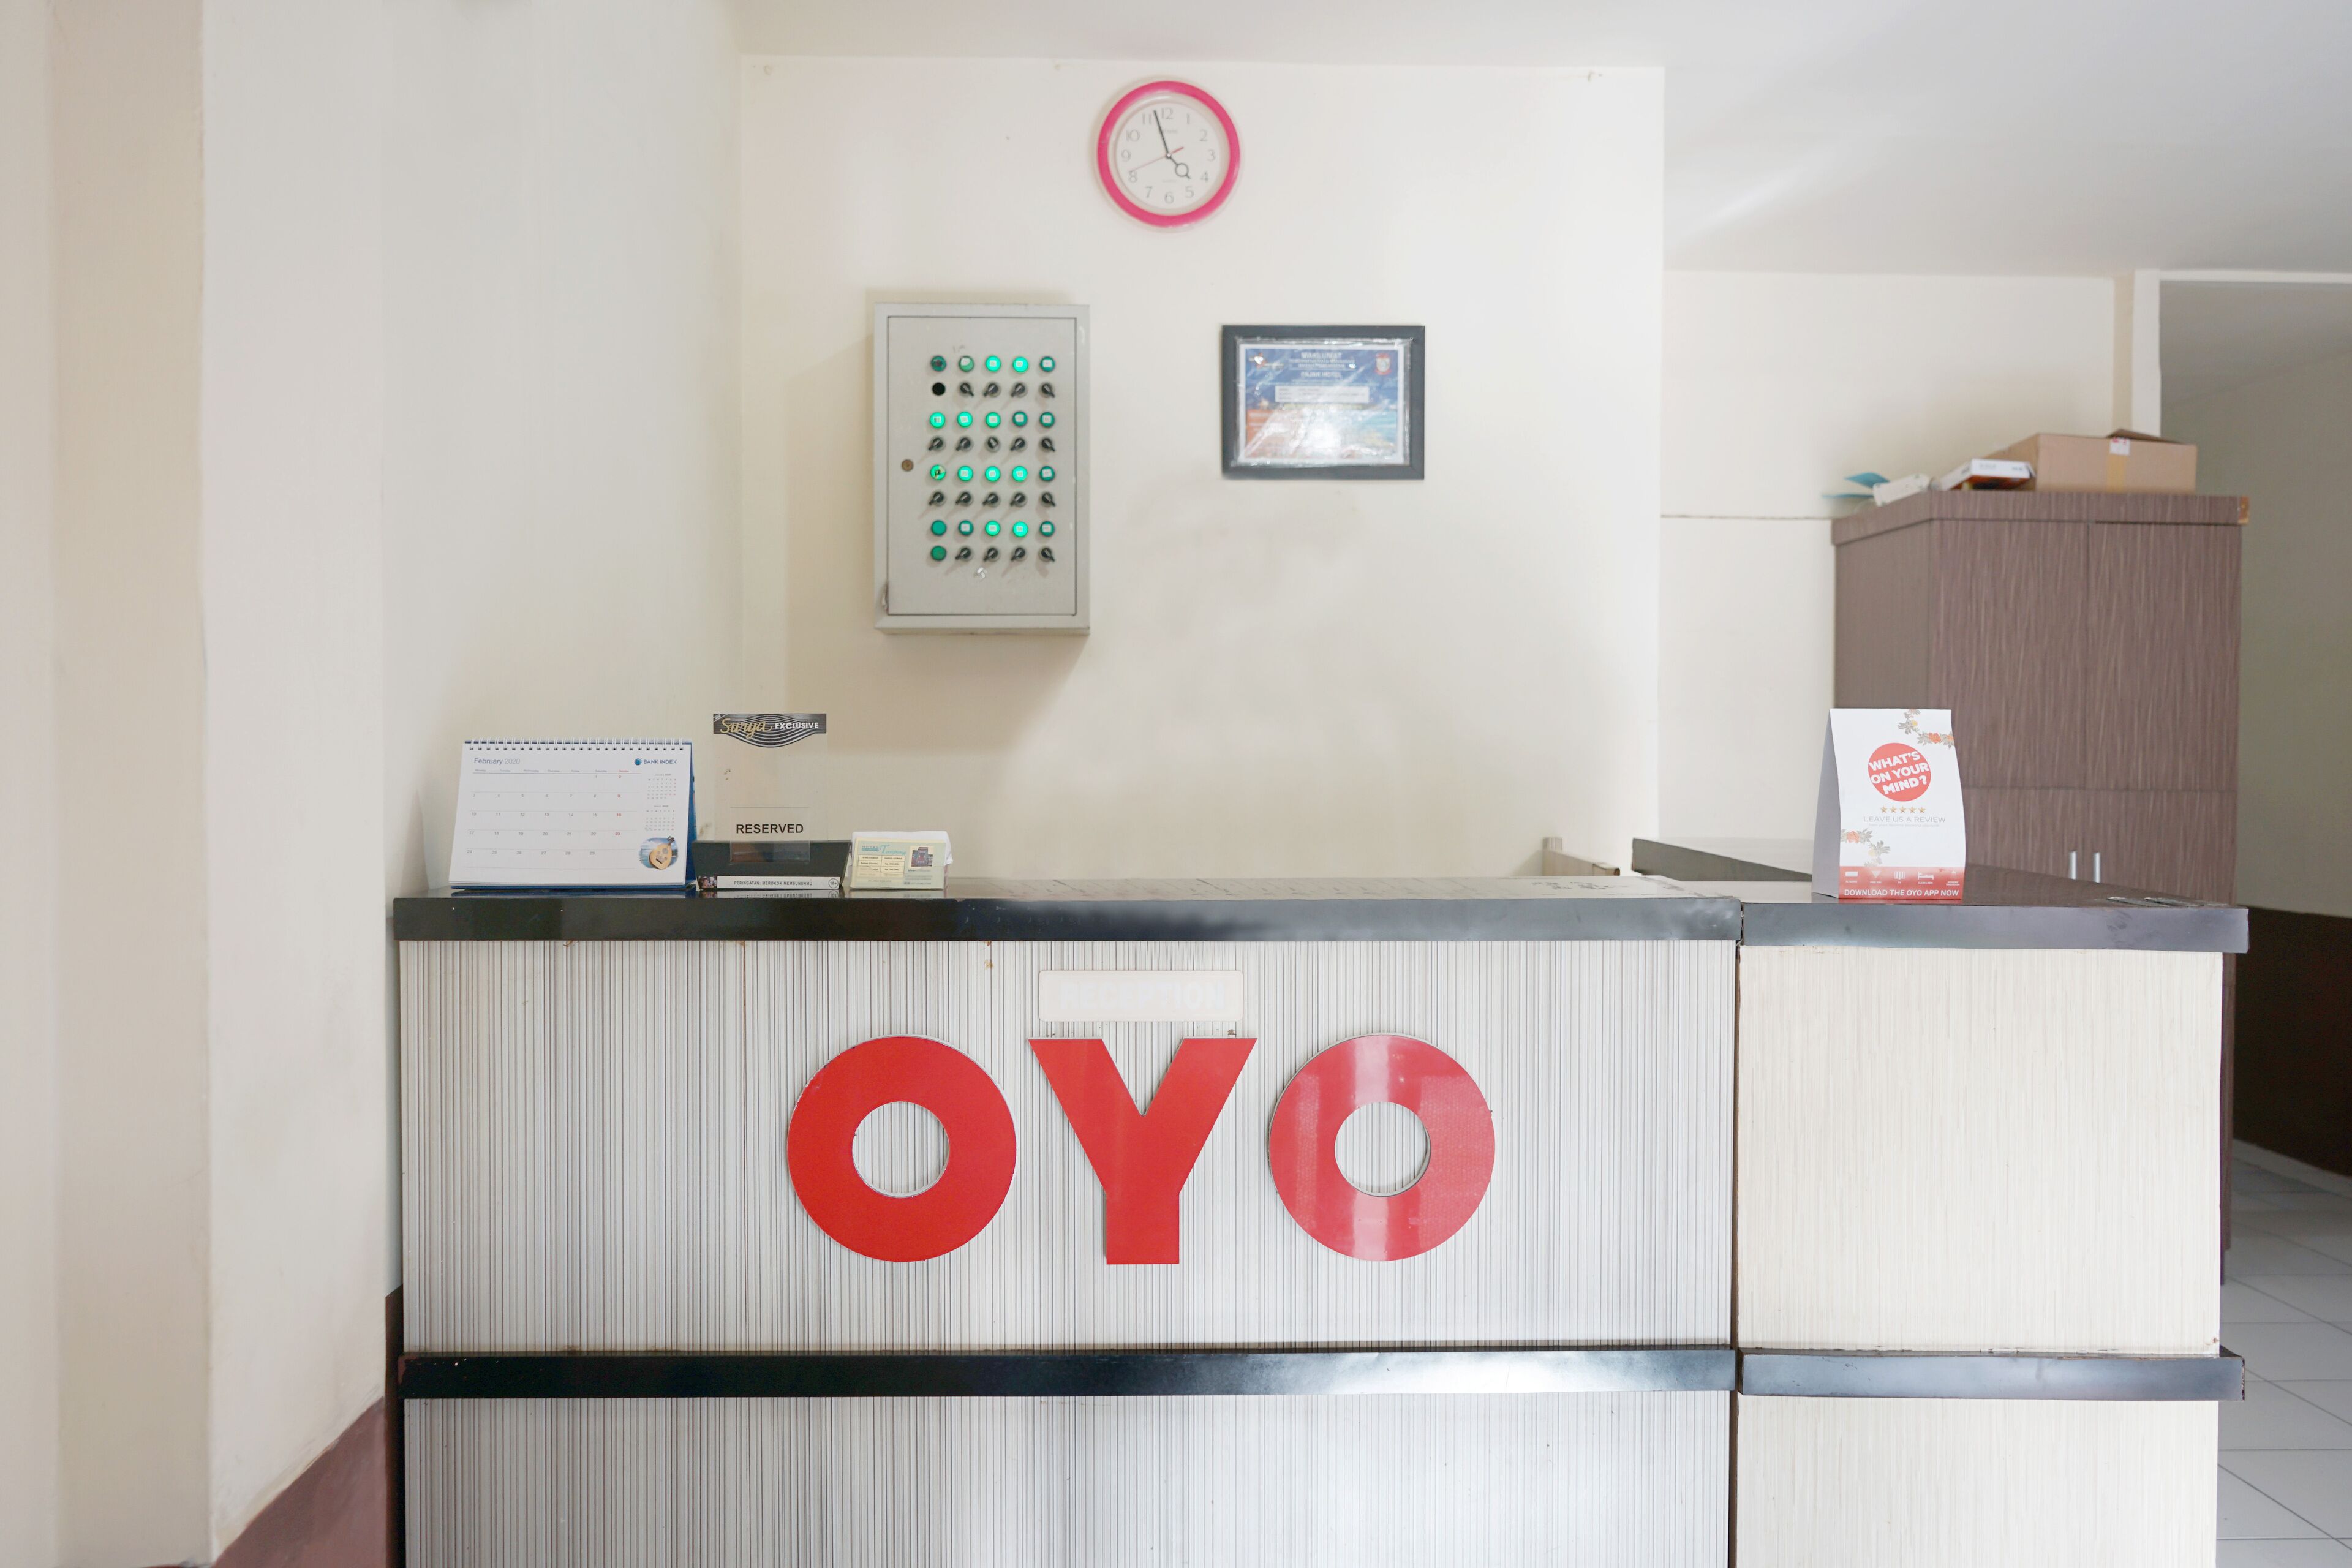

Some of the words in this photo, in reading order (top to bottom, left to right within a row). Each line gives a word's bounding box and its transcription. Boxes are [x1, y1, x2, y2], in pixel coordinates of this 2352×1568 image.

[1142, 113, 1153, 125] 11
[1161, 107, 1174, 120] 12
[1186, 113, 1190, 125] 1
[1126, 130, 1140, 142] 10
[1199, 130, 1208, 141] 2
[1121, 149, 1131, 162] 9
[1207, 149, 1216, 162] 3
[1128, 171, 1138, 183] 8
[1200, 172, 1209, 182] 4
[1145, 186, 1153, 198] 7
[1164, 192, 1175, 204] 6
[1185, 186, 1194, 198] 5
[720, 718, 772, 739] Surya
[775, 722, 819, 730] EXCLUSIVE
[1869, 750, 1920, 771] WHAT'S
[1871, 771, 1891, 784] ON
[1892, 762, 1929, 778] YOUR
[736, 823, 804, 834] RESERVED
[1058, 980, 1226, 1010] RECEPTION
[787, 1033, 1496, 1265] OYO
